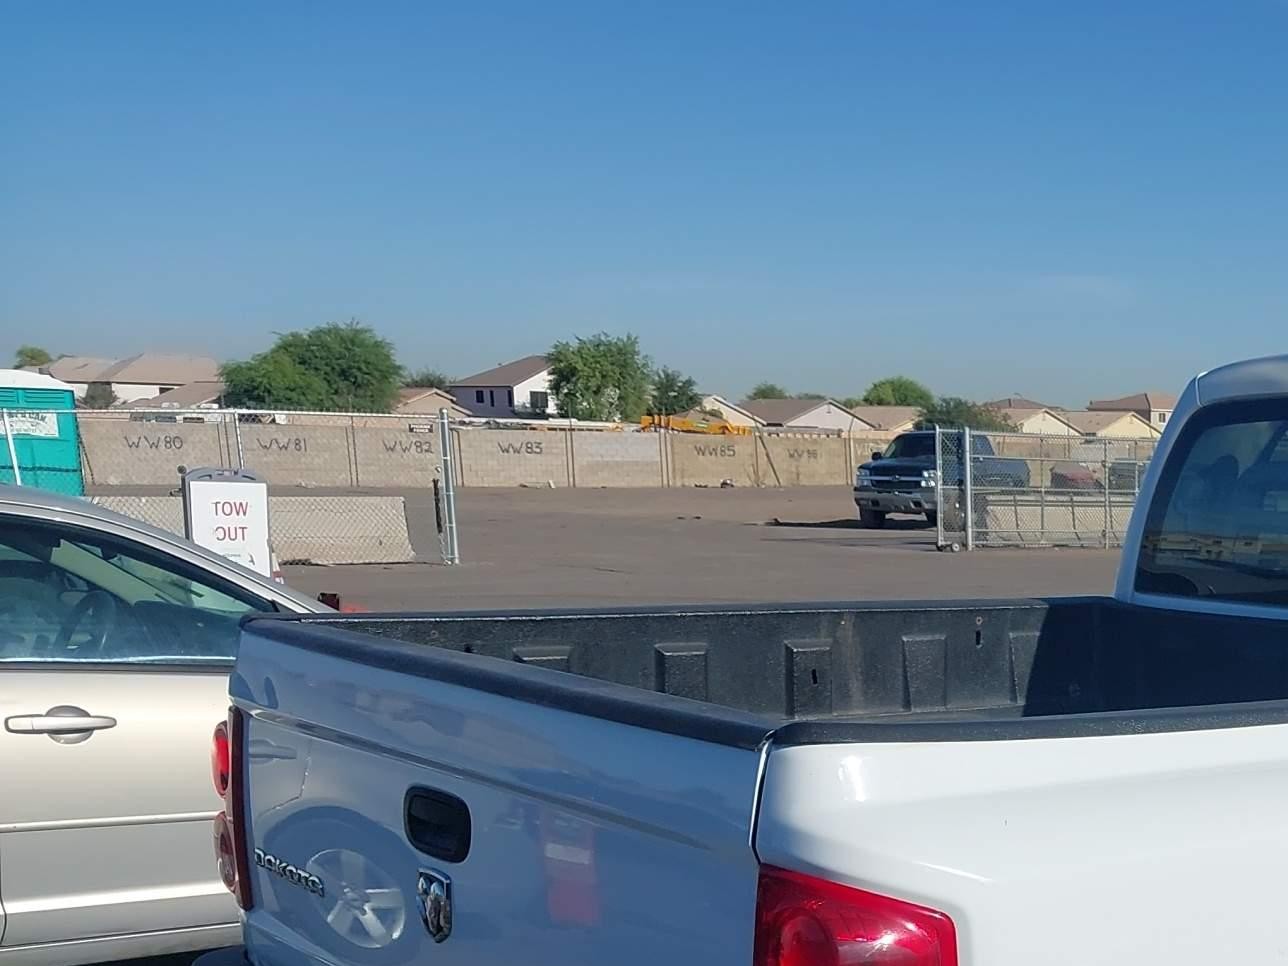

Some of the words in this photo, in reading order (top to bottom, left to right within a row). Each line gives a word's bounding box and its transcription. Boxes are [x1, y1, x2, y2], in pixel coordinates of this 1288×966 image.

[123, 435, 184, 450] WW80
[255, 437, 308, 452] WW81
[382, 439, 435, 454] WW82
[497, 441, 543, 454] WW83
[693, 444, 736, 457] WW85
[211, 501, 249, 517] TOW
